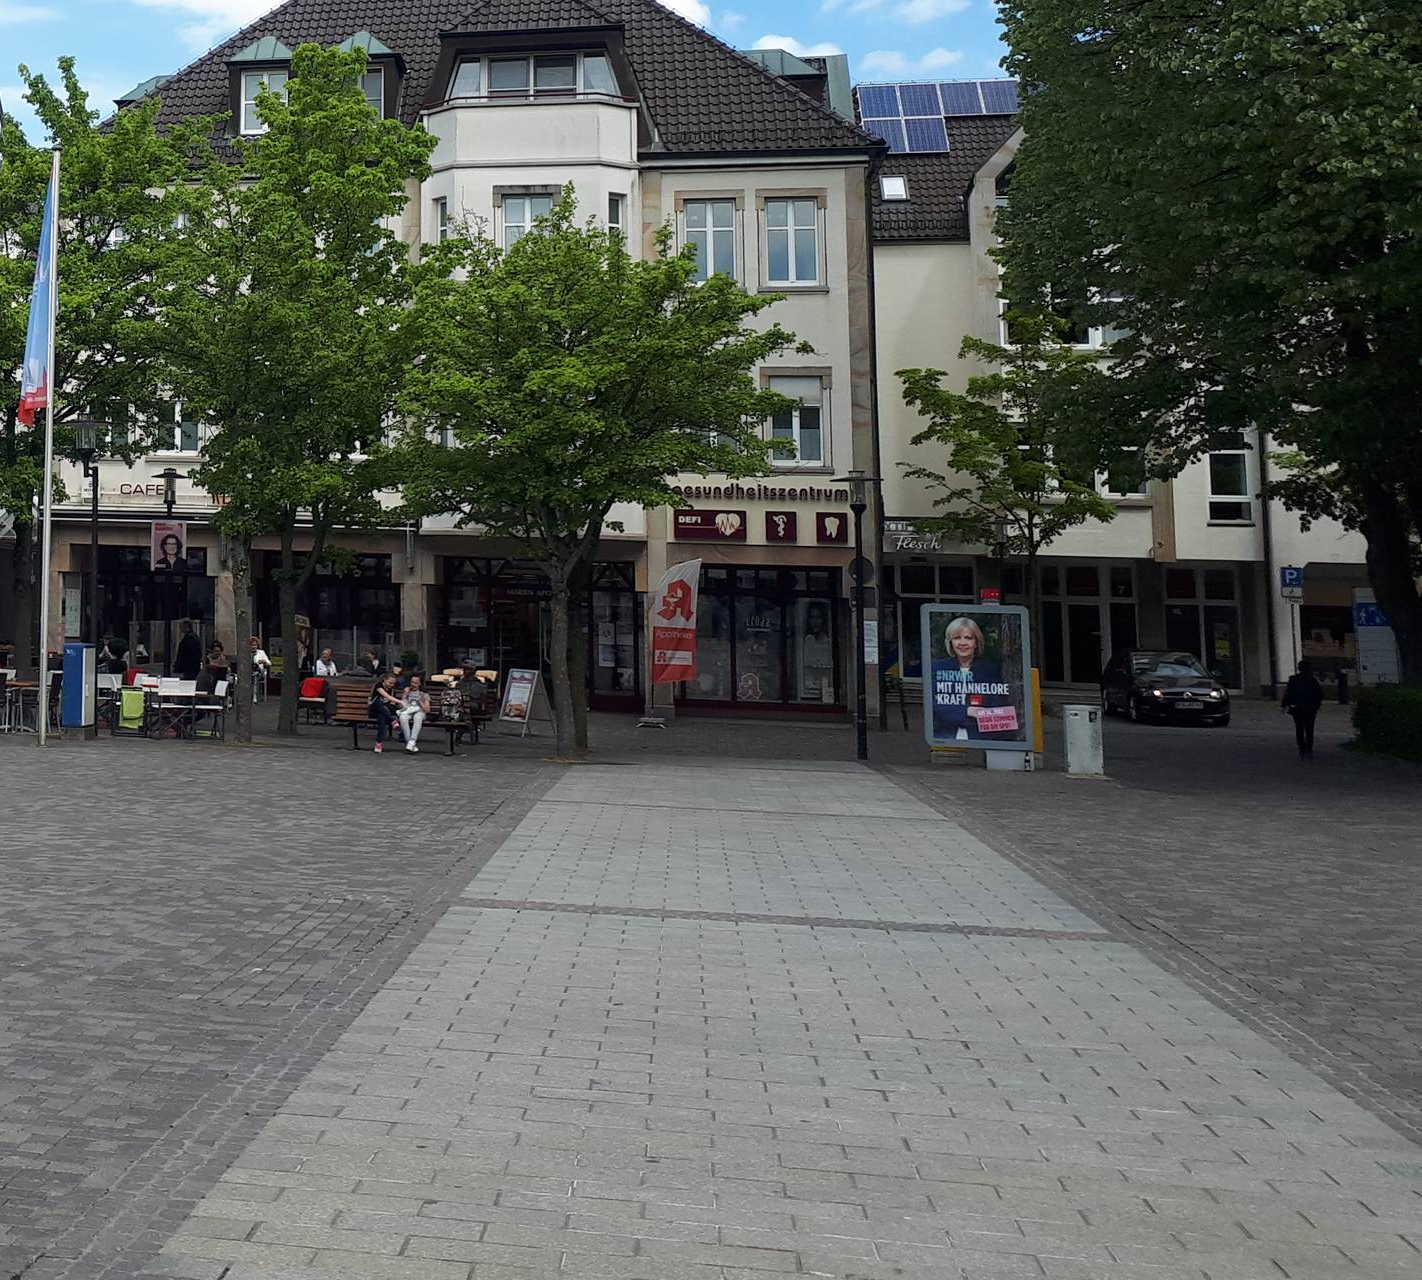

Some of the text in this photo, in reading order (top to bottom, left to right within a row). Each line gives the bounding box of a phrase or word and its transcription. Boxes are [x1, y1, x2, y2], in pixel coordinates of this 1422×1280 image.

[120, 483, 165, 496] CAFE
[678, 515, 702, 524] DEFI
[891, 535, 942, 550] Flesch
[1285, 569, 1297, 584] P
[936, 681, 1010, 695] MIT HANNELORE
[937, 694, 966, 705] KRAFT
